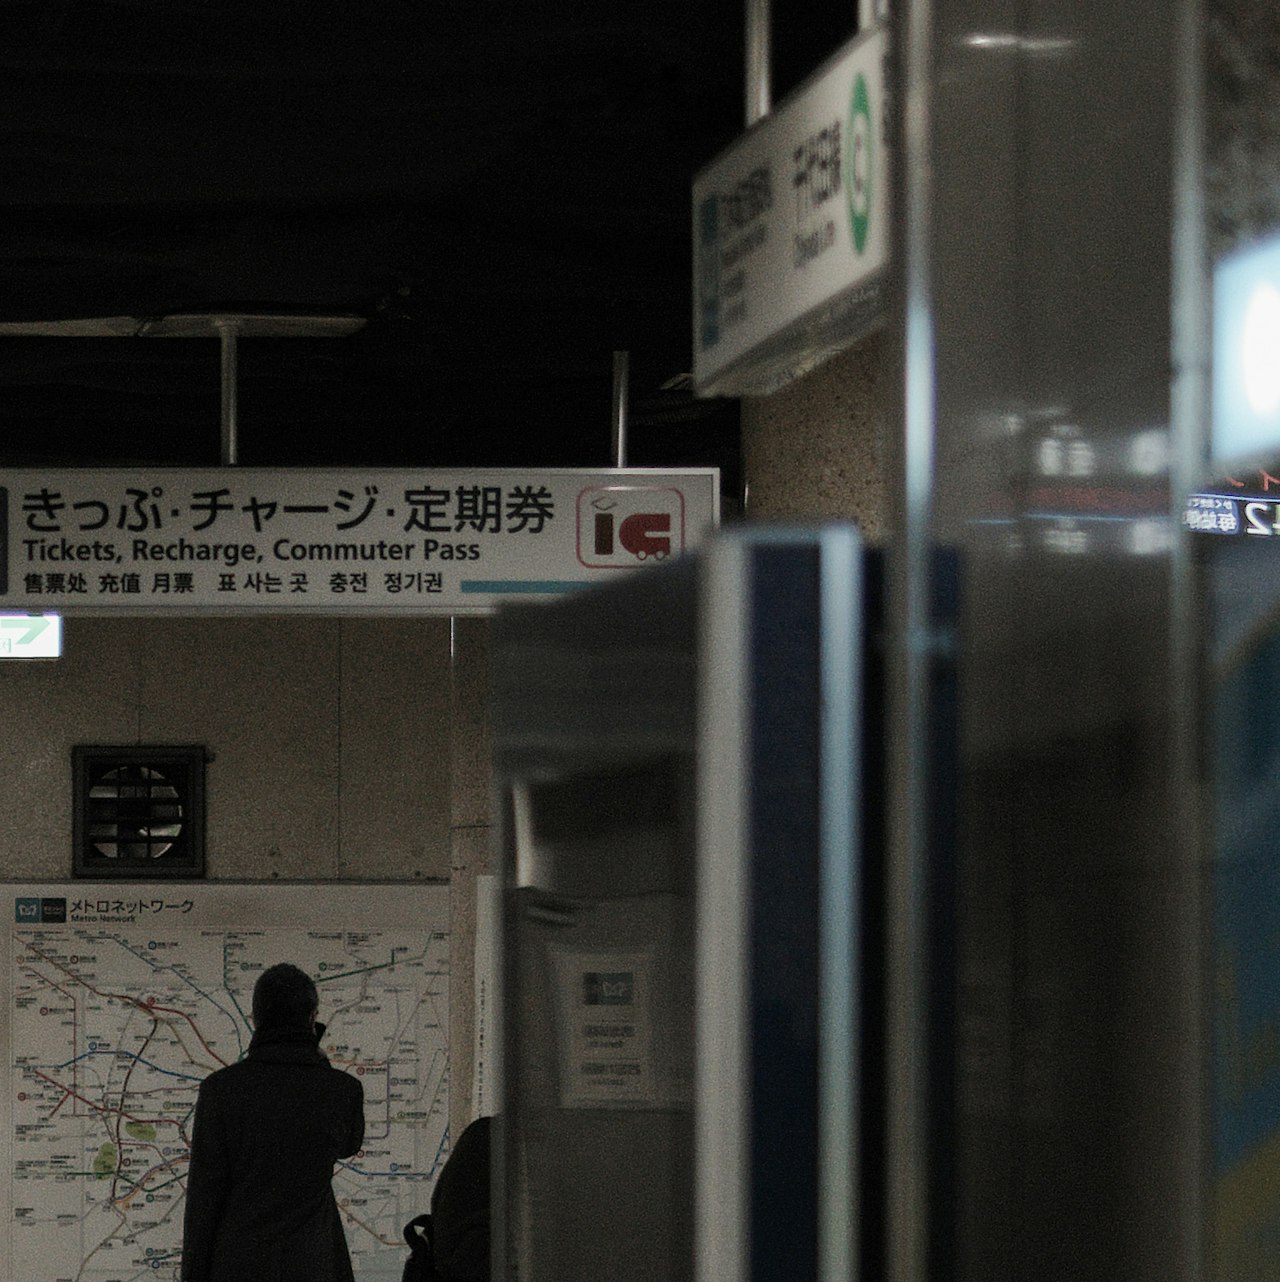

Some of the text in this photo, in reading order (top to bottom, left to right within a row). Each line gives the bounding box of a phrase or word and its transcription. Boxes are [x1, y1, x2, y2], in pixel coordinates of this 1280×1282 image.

[22, 539, 480, 566] Tickets, Recharge, Commuter Pass
[24, 573, 194, 594] 售票处 充值 月票
[217, 573, 443, 593] 표 사는 곳 충전 정기권
[70, 899, 194, 913] メトロネットワーク
[71, 914, 136, 923] Metro Network
